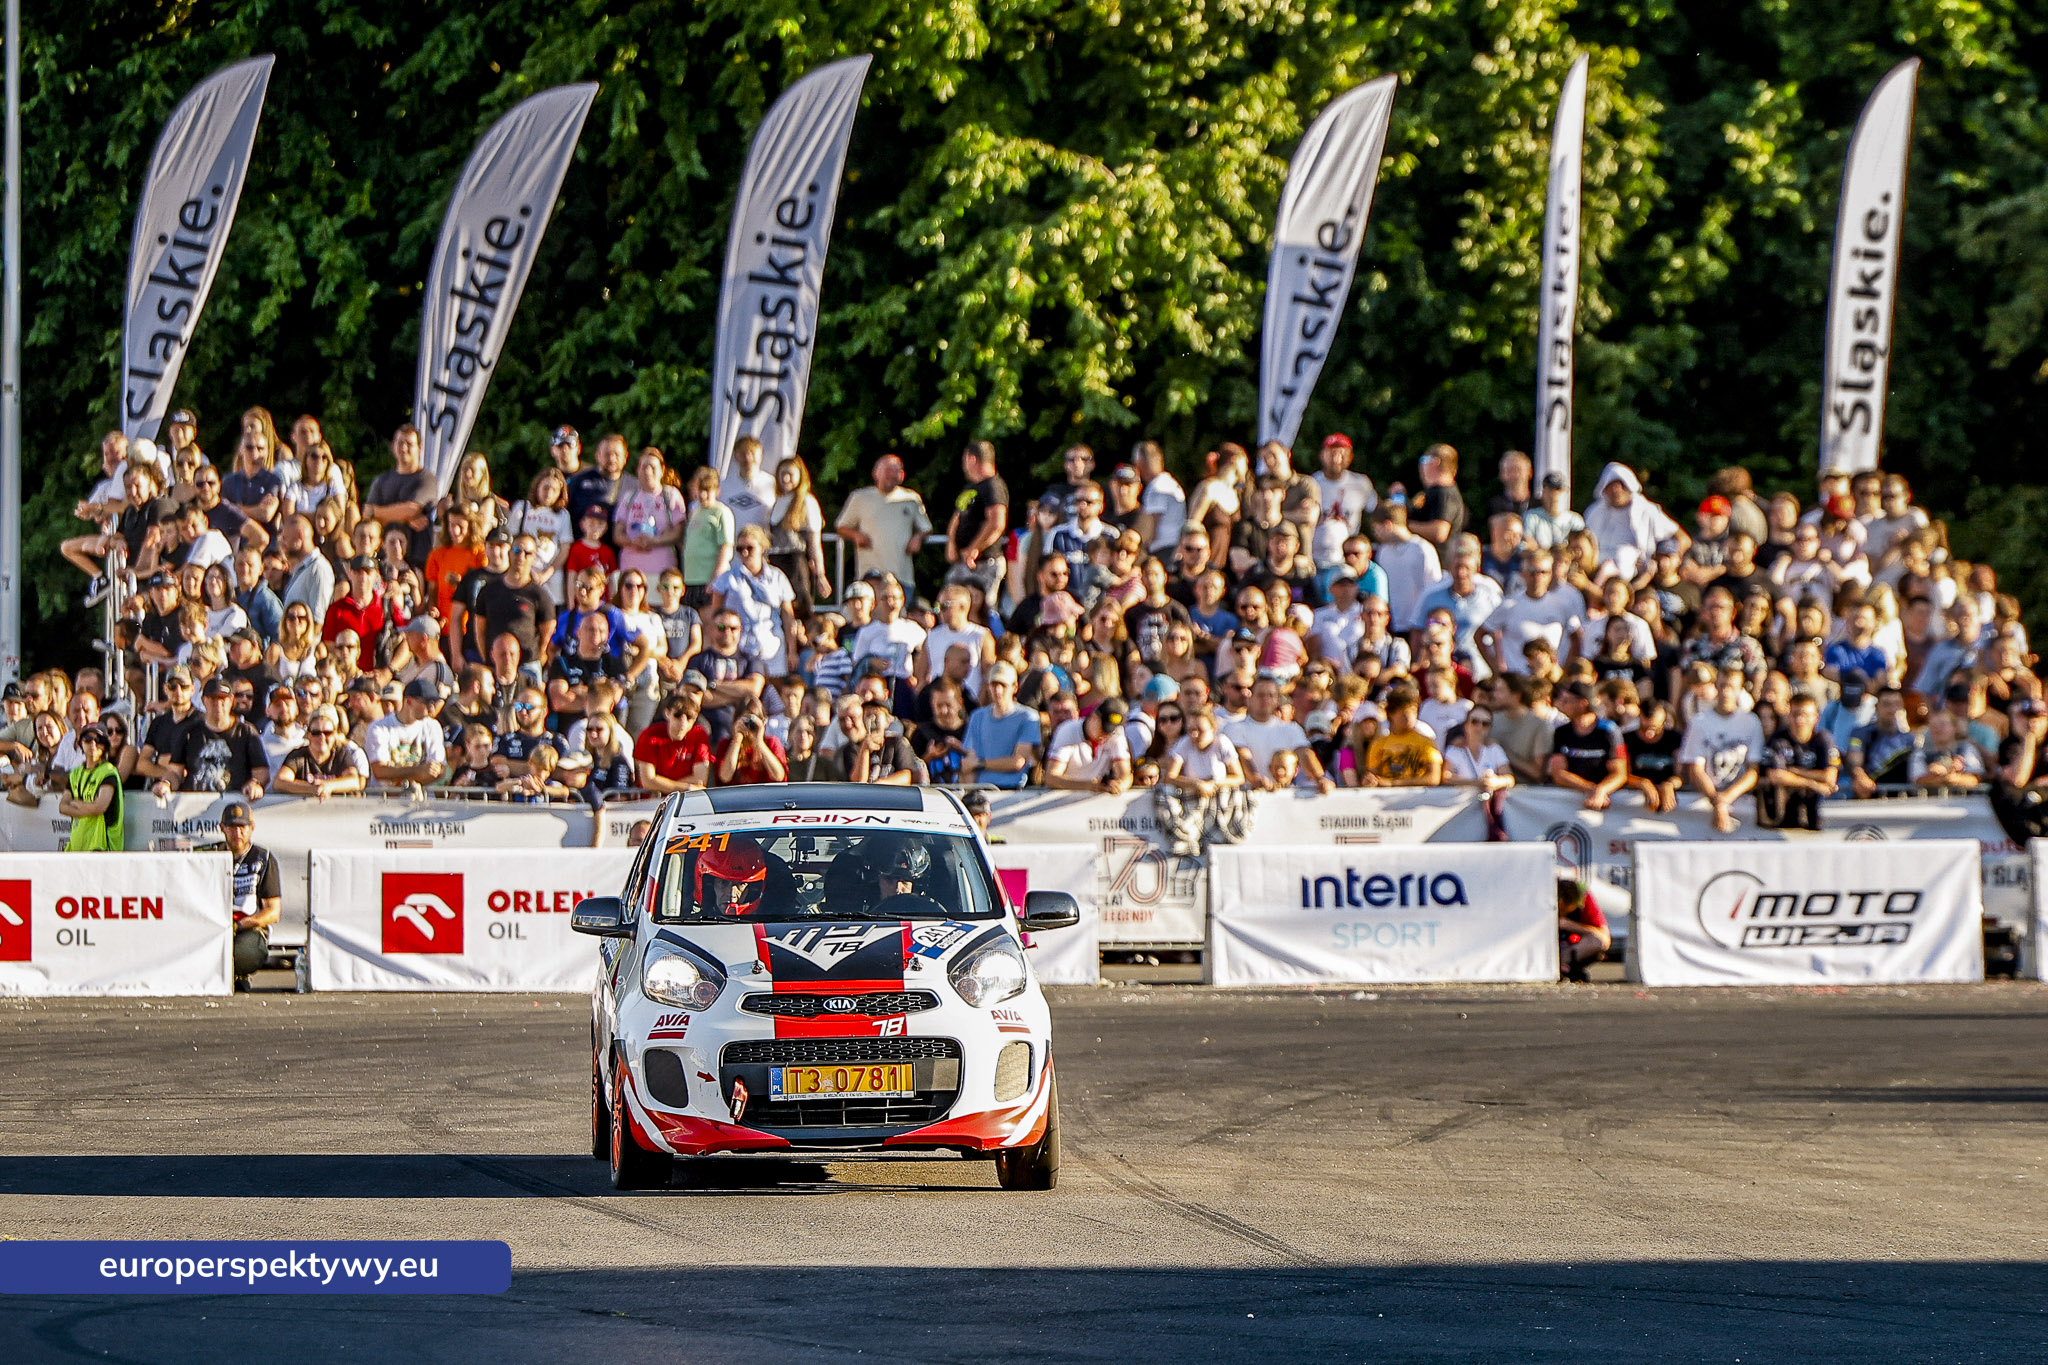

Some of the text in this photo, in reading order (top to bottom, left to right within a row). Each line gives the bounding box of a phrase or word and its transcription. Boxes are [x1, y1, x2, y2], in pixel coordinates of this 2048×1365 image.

[726, 181, 819, 424] Śląskie.
[370, 822, 420, 836] STADION
[1320, 815, 1369, 829] STADION
[665, 832, 731, 854] 241
[1301, 866, 1469, 909] interia
[55, 896, 163, 920] ORLEN
[1751, 890, 1923, 918] MOTO
[56, 927, 95, 947] OIL
[488, 922, 527, 940] OIL
[918, 927, 948, 943] 241
[1331, 921, 1440, 949] SPORT
[828, 999, 852, 1010] KIA
[872, 1017, 905, 1037] 78
[772, 1084, 782, 1092] PL
[789, 1066, 899, 1093] T3 0781
